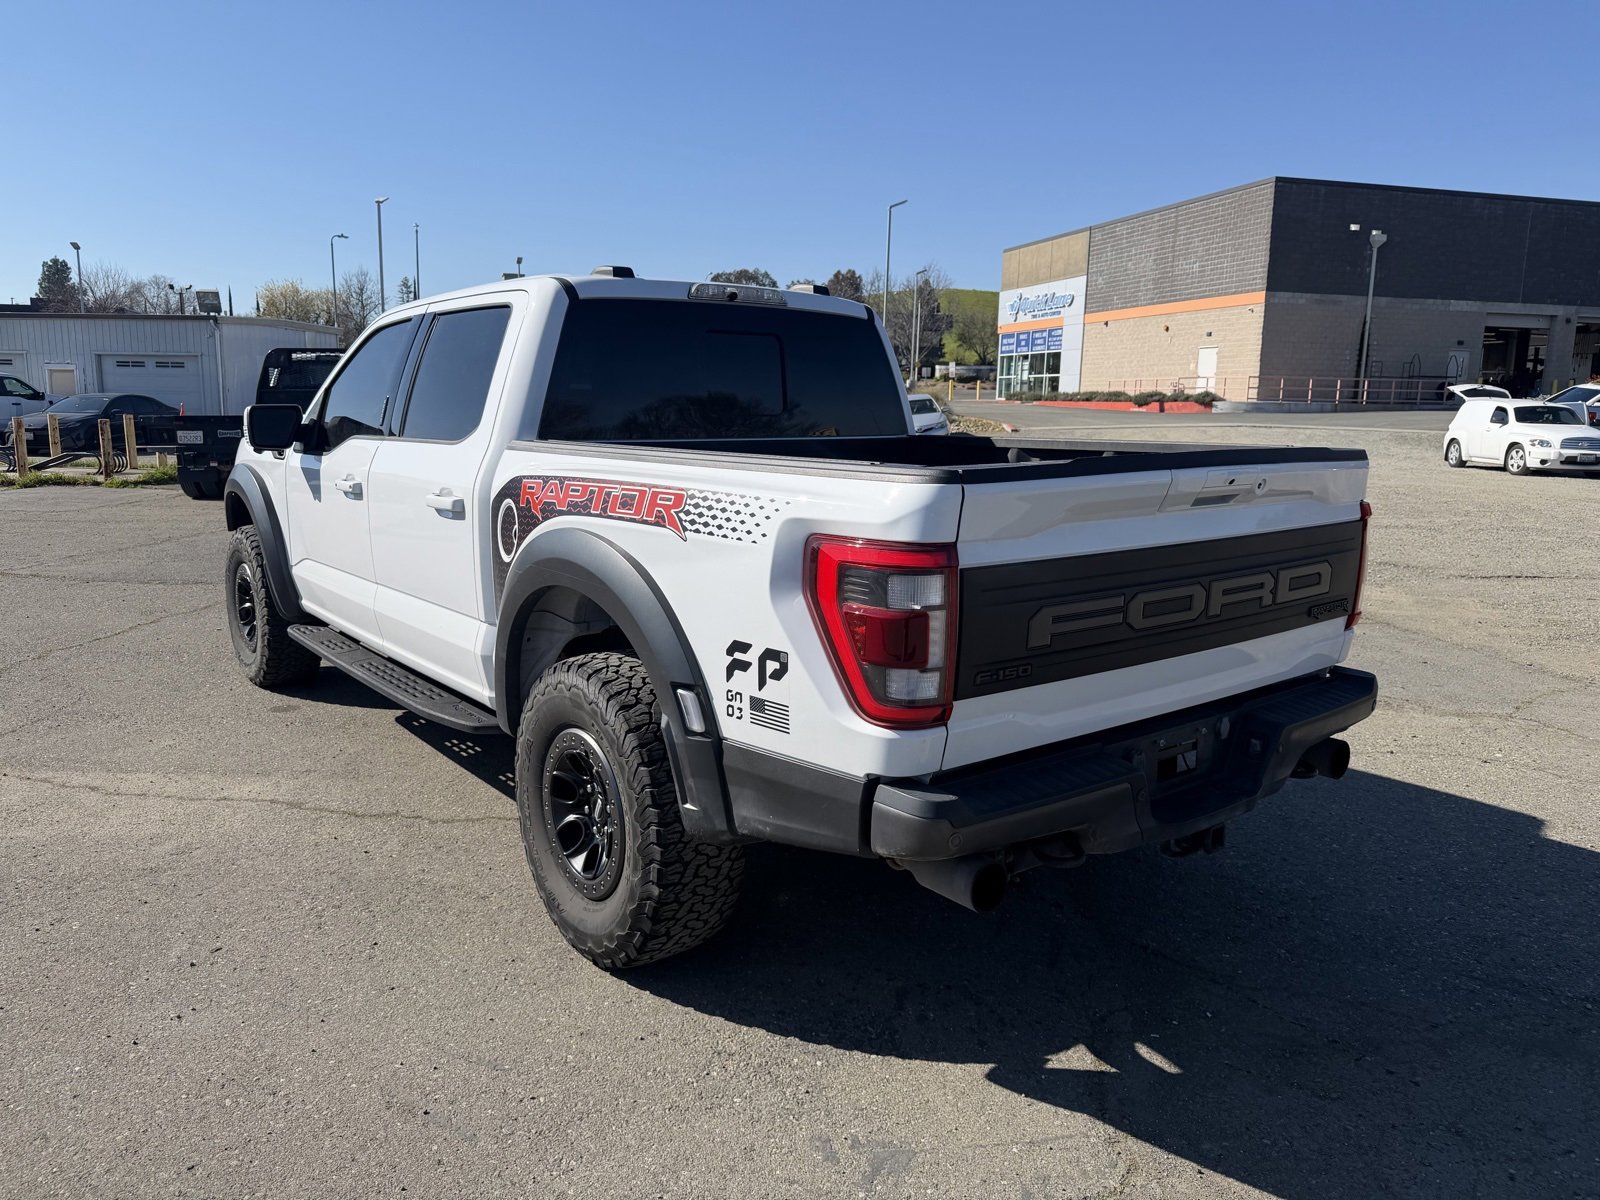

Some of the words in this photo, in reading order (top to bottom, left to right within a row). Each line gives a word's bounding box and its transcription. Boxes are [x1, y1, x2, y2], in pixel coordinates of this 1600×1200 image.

[1046, 292, 1074, 309] Lane
[520, 479, 687, 542] RAPTOR
[1026, 559, 1333, 651] FORD
[1309, 599, 1349, 619] RAPTOR
[974, 663, 1033, 687] F-150
